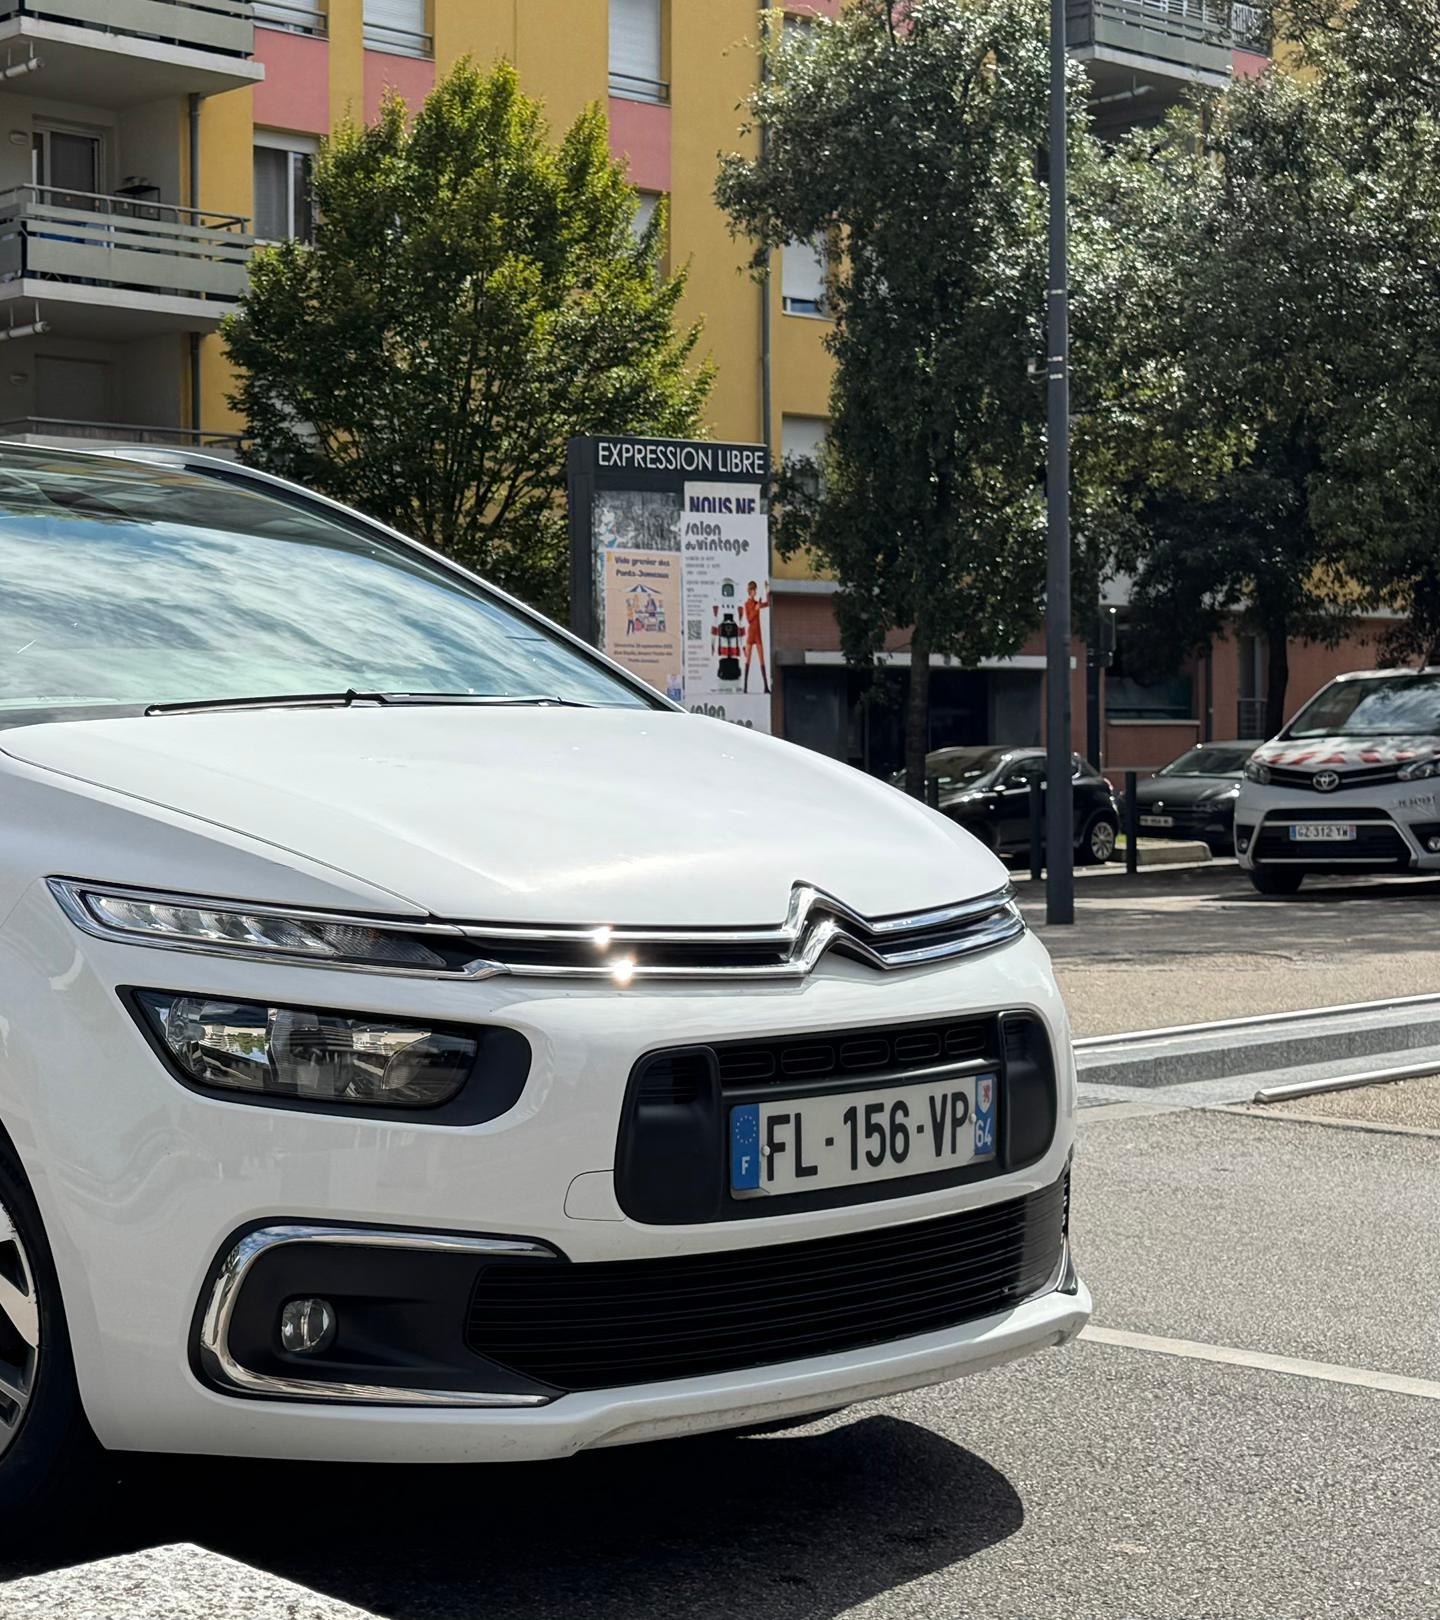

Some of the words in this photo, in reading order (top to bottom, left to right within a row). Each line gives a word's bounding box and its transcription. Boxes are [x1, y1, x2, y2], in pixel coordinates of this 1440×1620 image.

[598, 442, 712, 472] EXPRESSION
[718, 449, 764, 475] LIBRE
[689, 496, 733, 514] NOUS
[735, 497, 756, 515] NE
[685, 520, 722, 536] salon
[696, 537, 750, 557] vintage
[766, 1090, 970, 1182] FL-156-VP
[974, 1117, 993, 1148] 64
[740, 1155, 750, 1176] F
